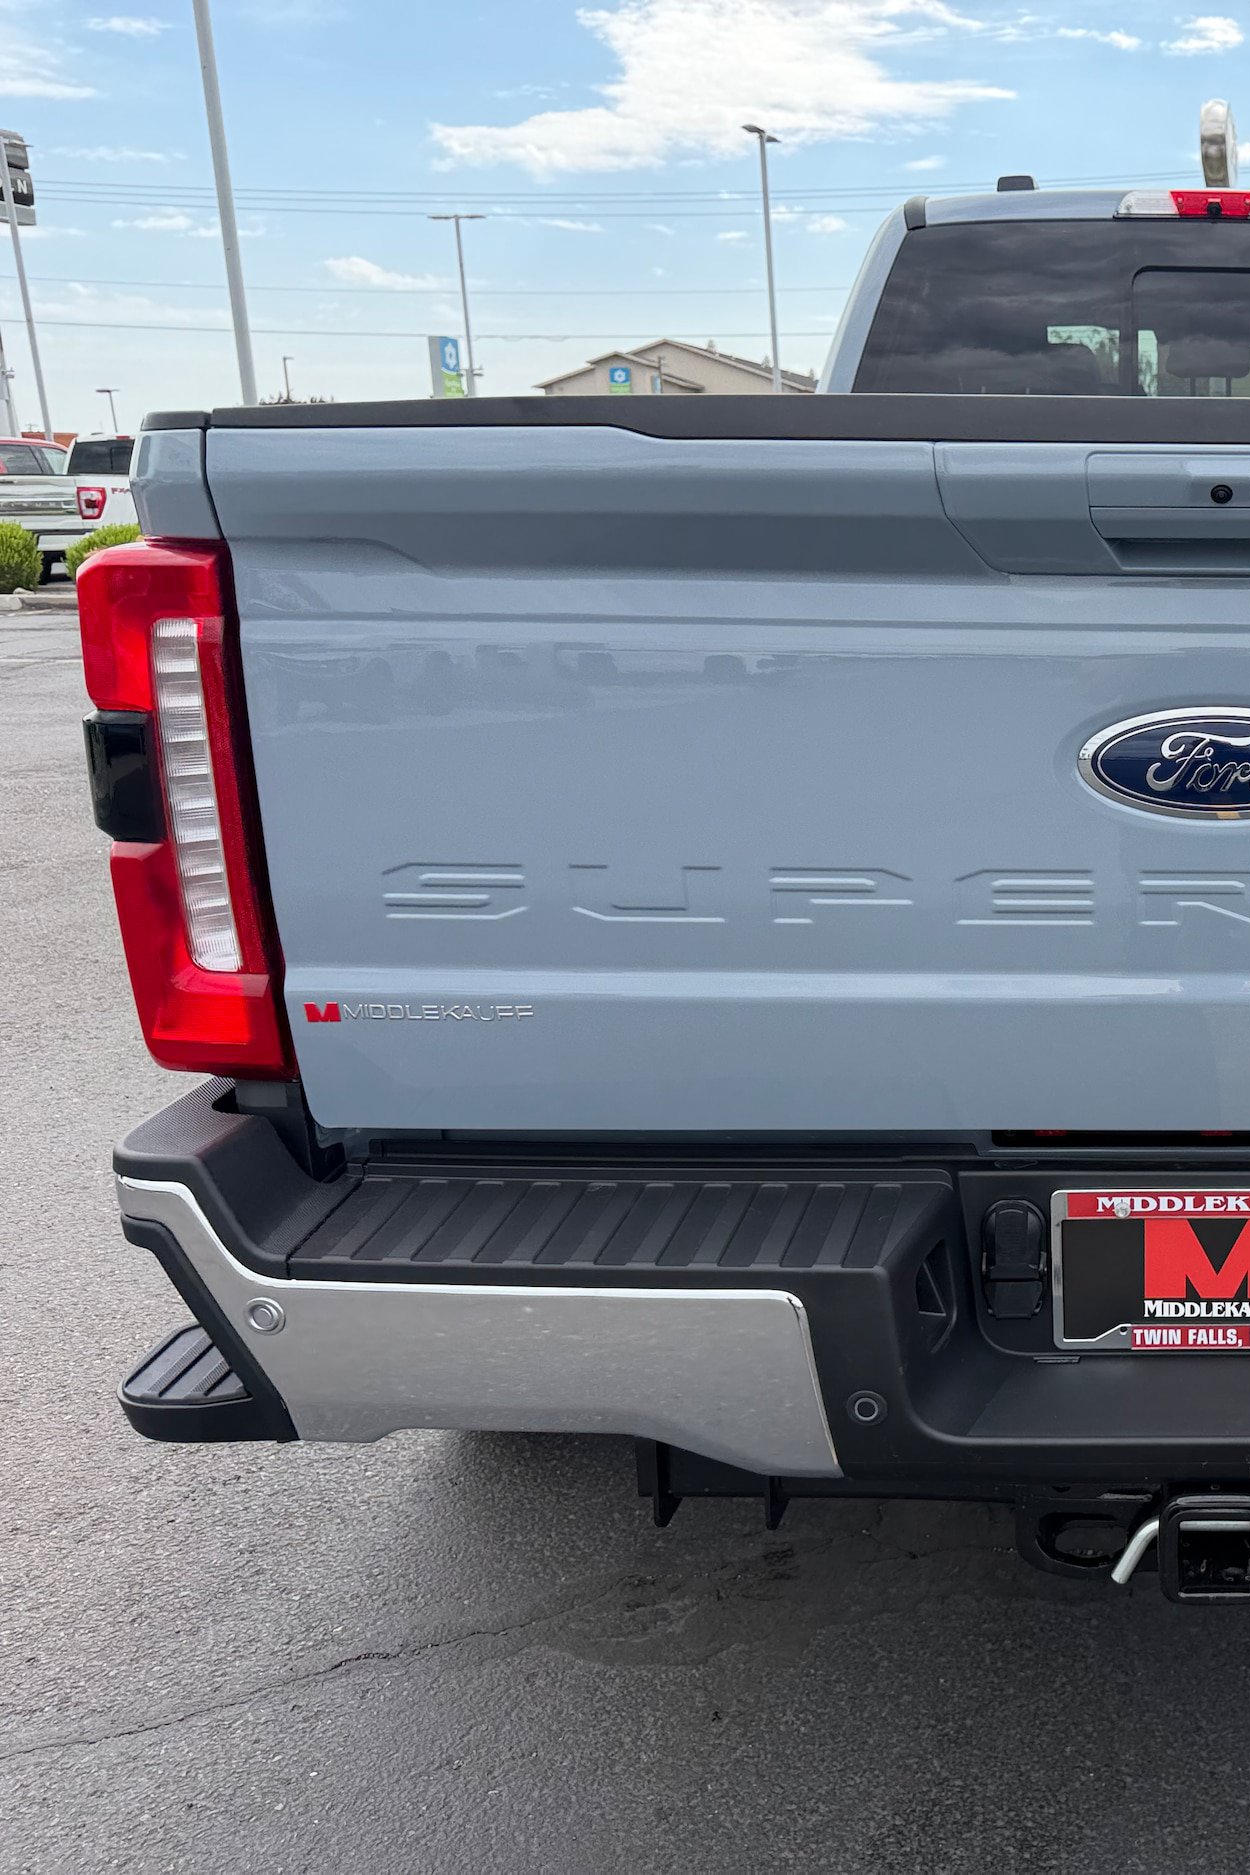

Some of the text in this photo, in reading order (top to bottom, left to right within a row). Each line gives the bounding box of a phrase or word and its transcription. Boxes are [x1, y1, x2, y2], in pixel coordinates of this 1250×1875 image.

[343, 1003, 534, 1022] MIDDLEKAUFF
[1133, 1329, 1185, 1346] TWIN
[1188, 1329, 1243, 1348] FALLS,
